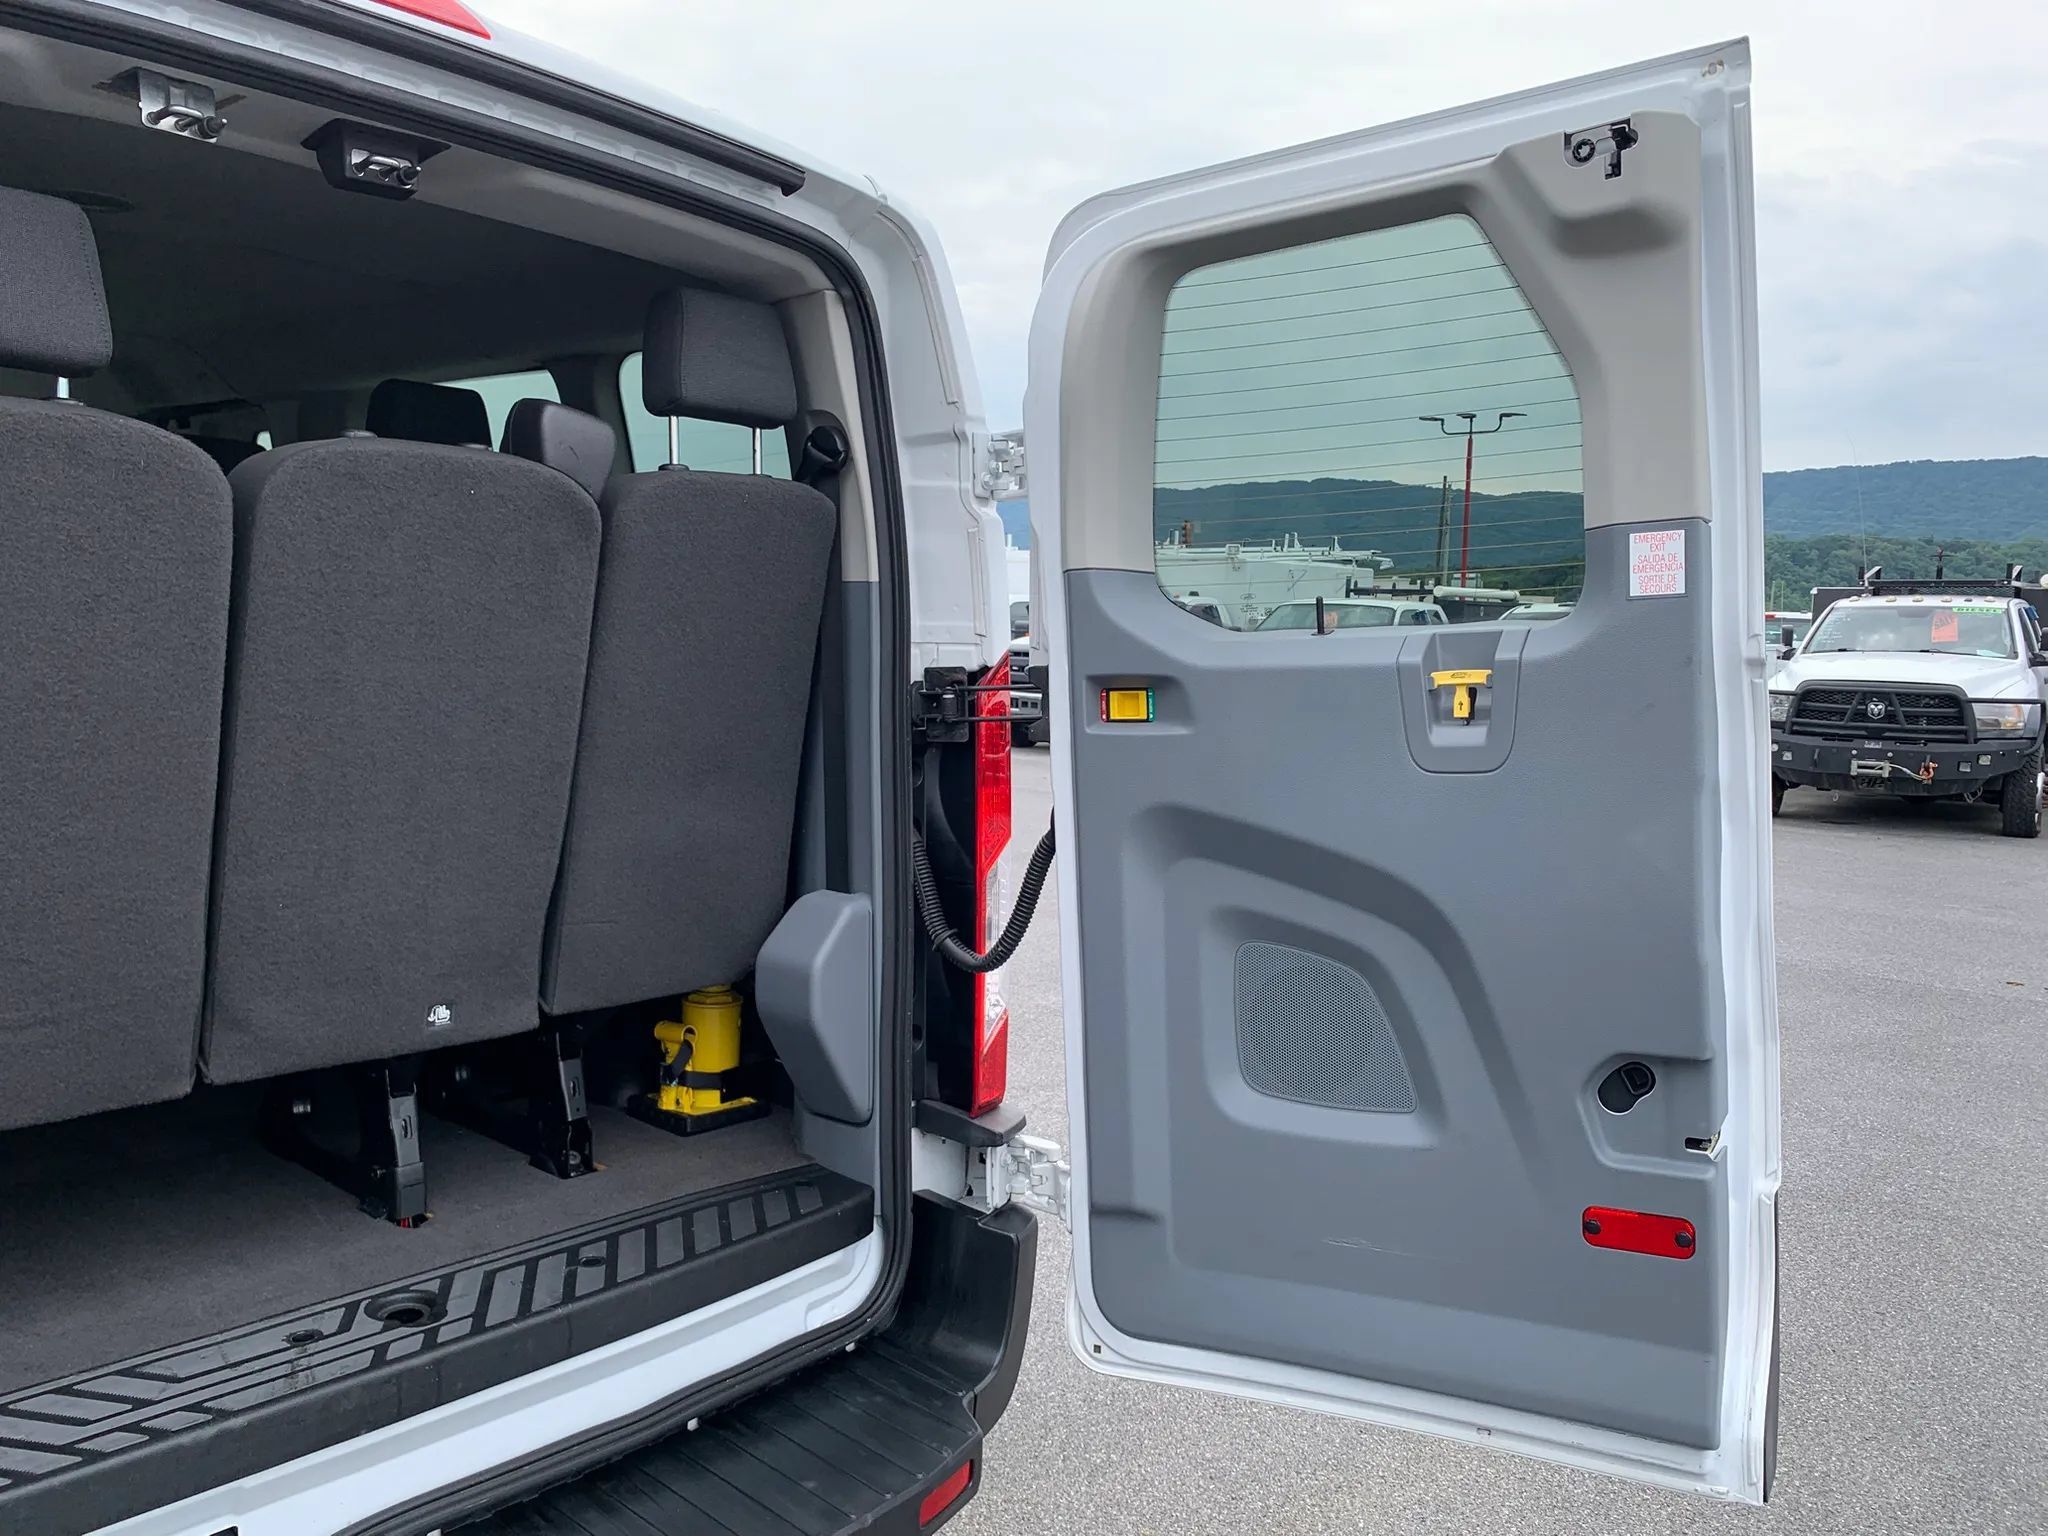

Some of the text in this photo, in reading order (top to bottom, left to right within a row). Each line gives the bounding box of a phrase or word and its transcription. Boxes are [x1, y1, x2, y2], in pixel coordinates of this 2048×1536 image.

[1634, 532, 1682, 544] EMERGENCY
[1650, 543, 1665, 552] EXIT
[1638, 553, 1678, 564] SALIDA DE
[1633, 562, 1683, 574] EMERGENCIA
[1639, 574, 1677, 584] SORTIE DE
[1640, 584, 1676, 594] SECOURS
